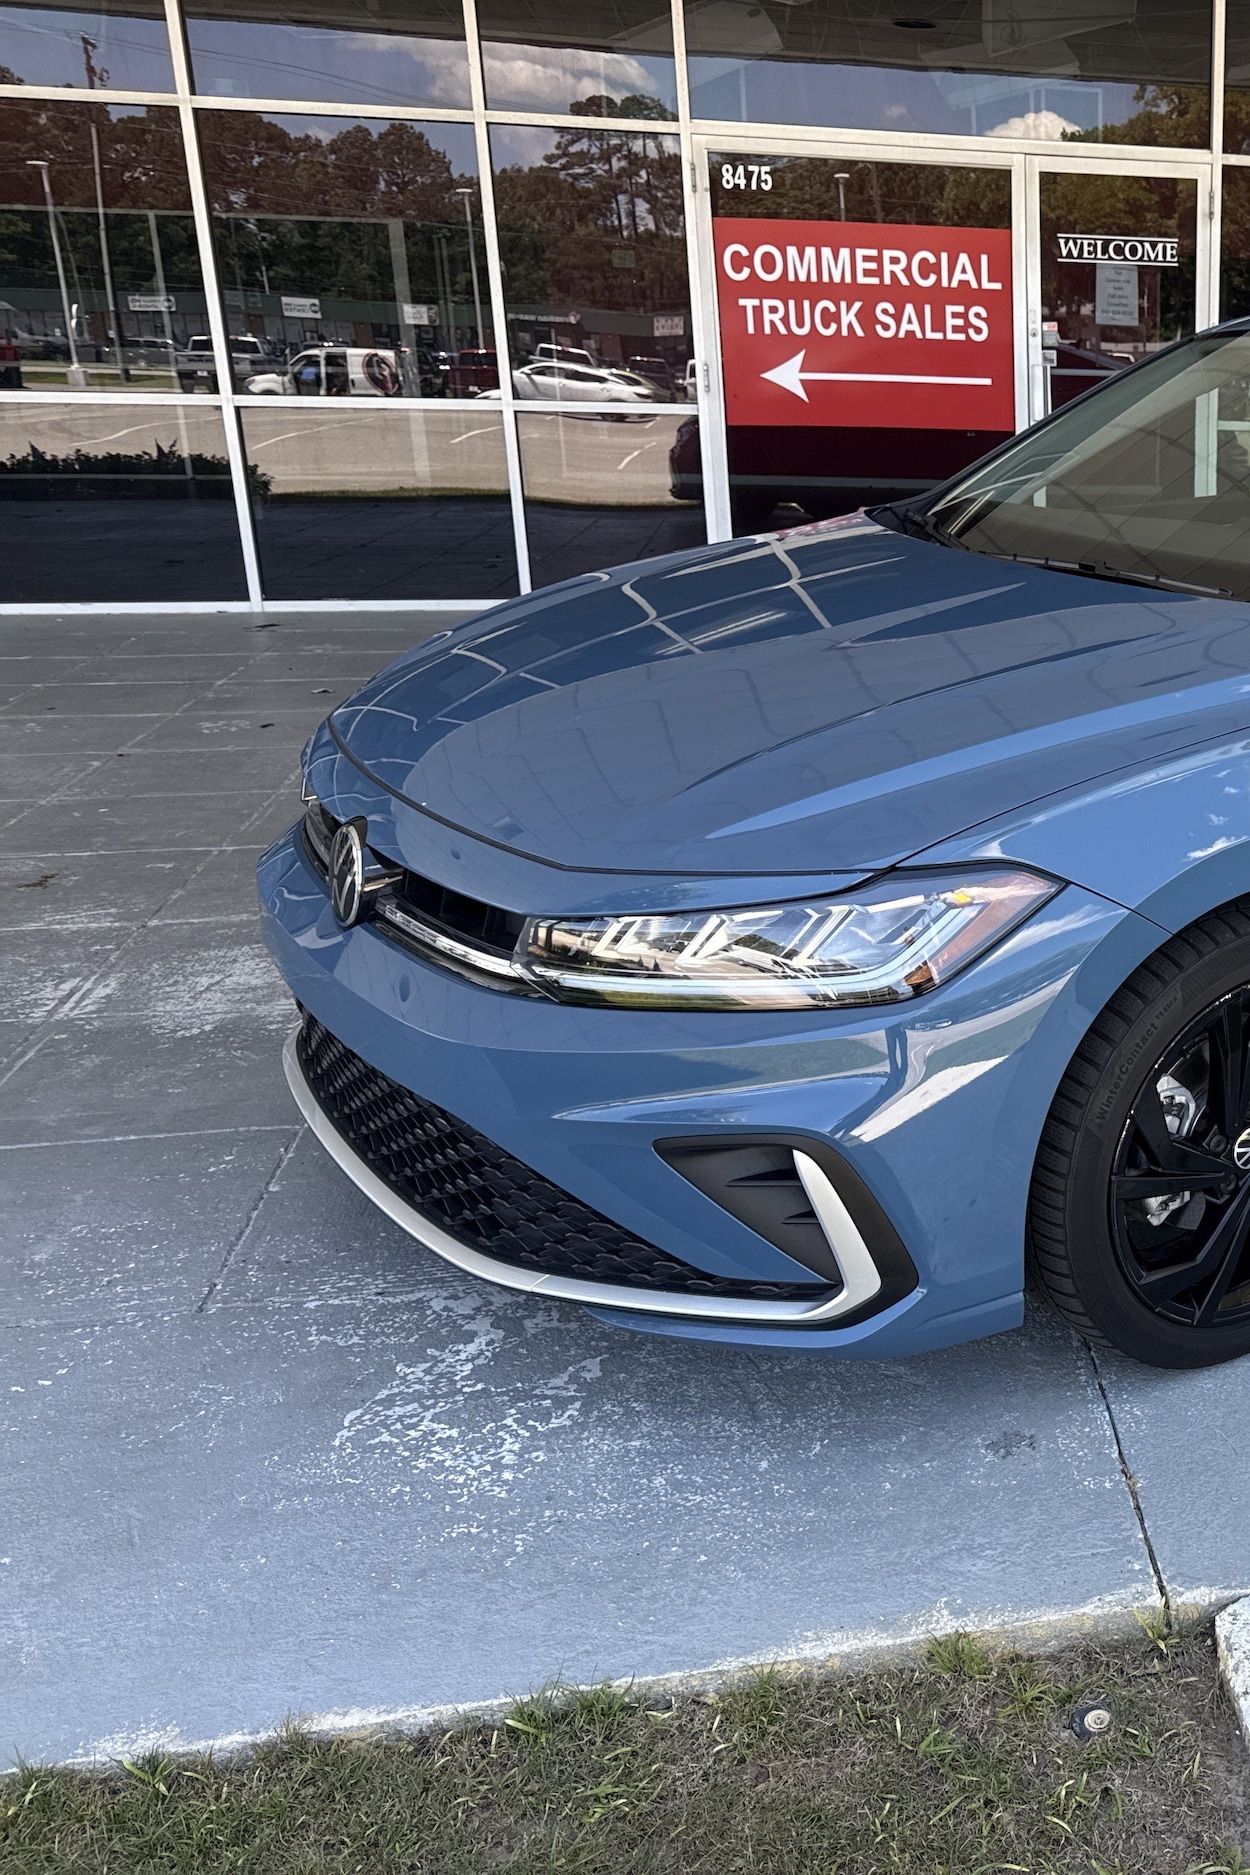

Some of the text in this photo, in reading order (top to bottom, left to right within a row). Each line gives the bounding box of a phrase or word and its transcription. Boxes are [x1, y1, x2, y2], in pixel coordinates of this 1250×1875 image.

[722, 164, 772, 191] 8475
[722, 243, 1003, 291] COMMERCIAL
[1057, 238, 1179, 263] WELCOME
[738, 298, 989, 342] TRUCK SALES
[1097, 1022, 1158, 1119] WinterContact
